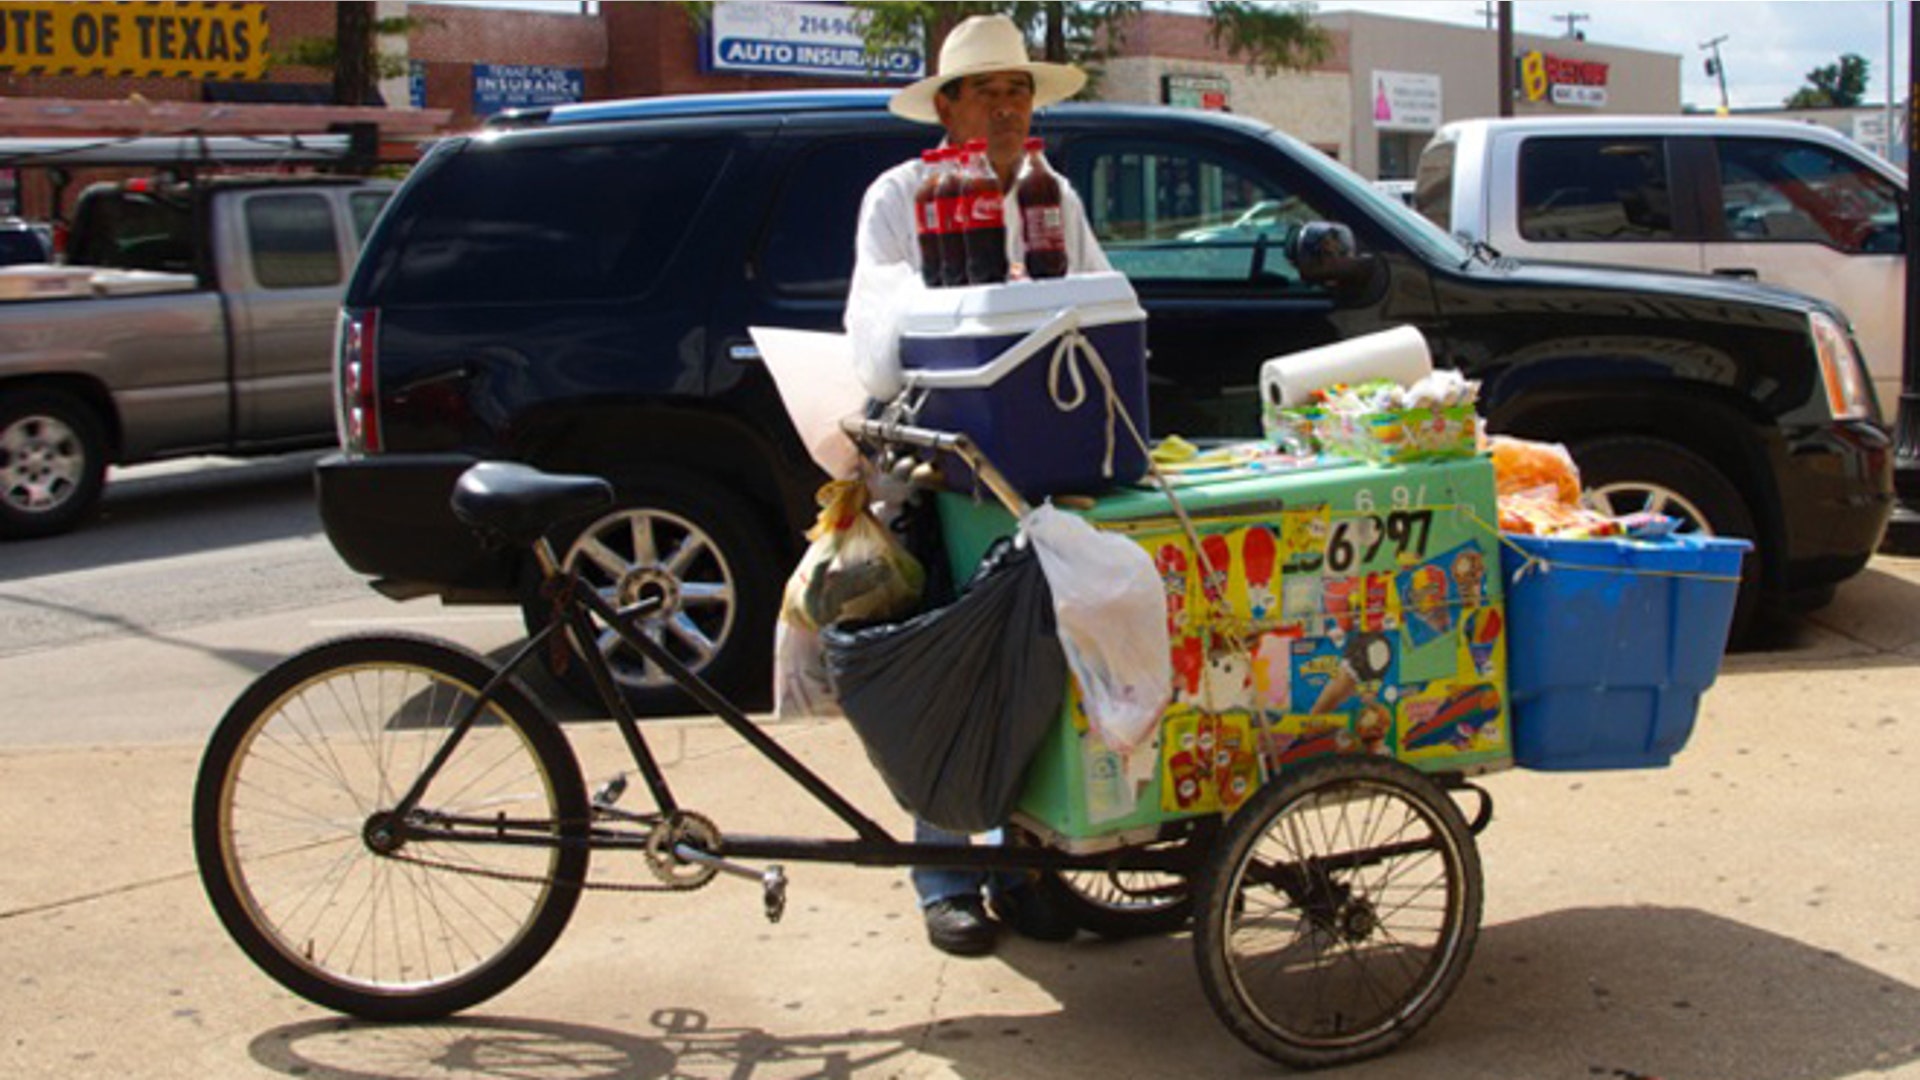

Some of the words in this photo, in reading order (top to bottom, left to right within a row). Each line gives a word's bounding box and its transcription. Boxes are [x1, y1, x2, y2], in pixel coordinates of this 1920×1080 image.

[72, 12, 120, 57] OF
[136, 15, 248, 61] TEXAS
[727, 41, 793, 63] AUTO
[476, 77, 580, 95] INSURANCE
